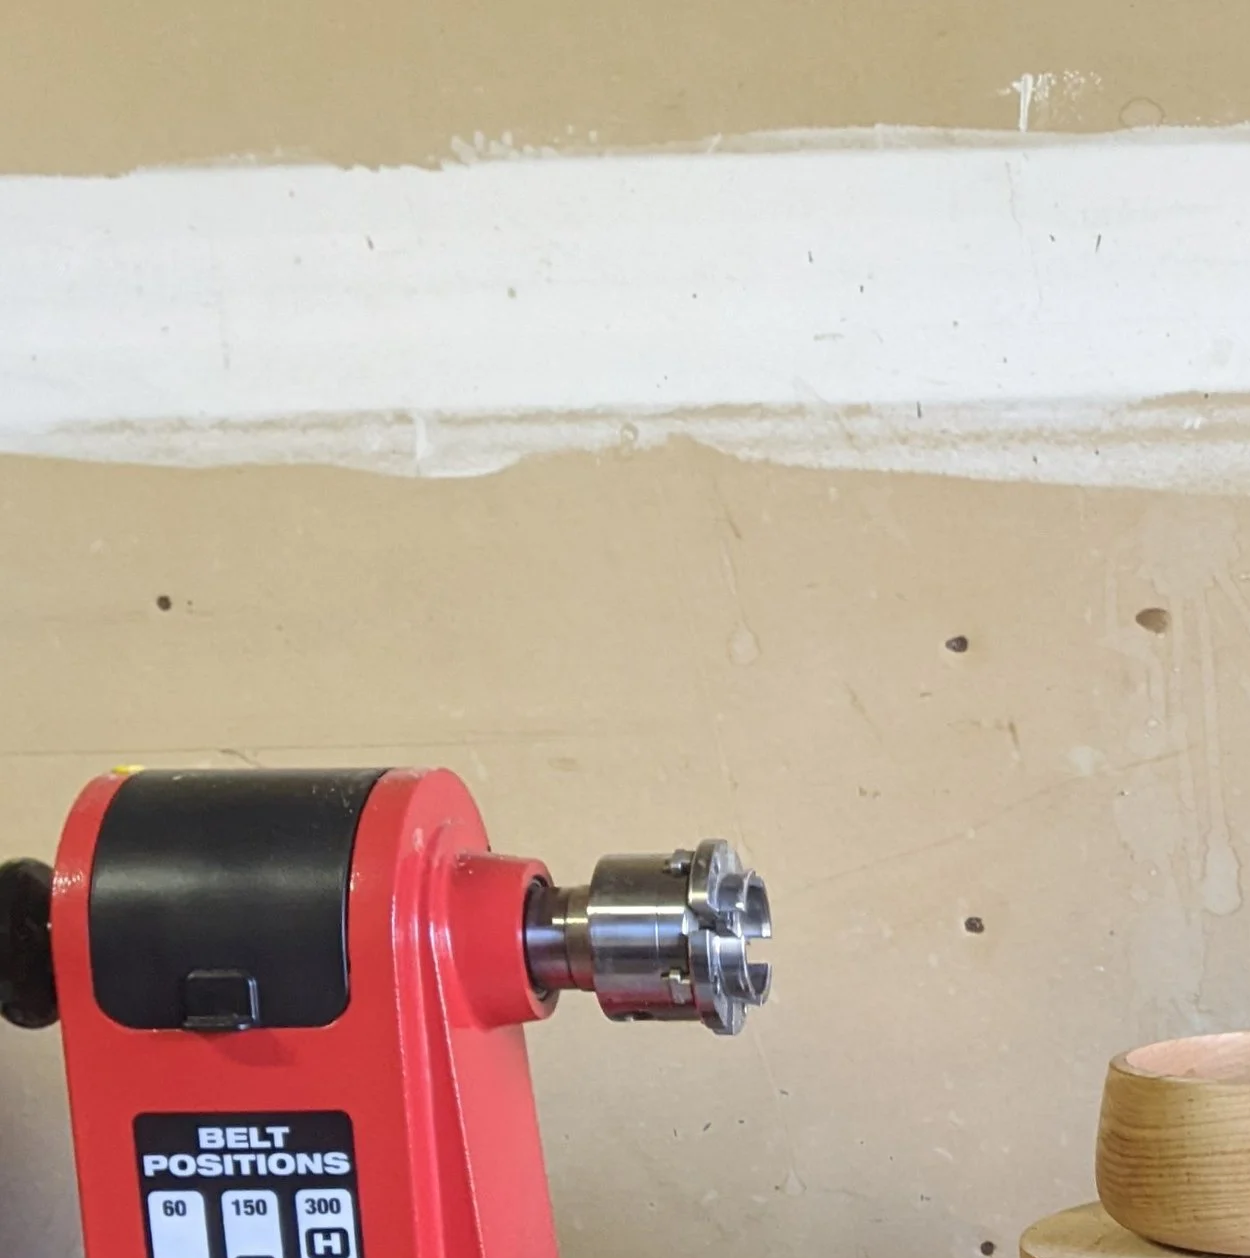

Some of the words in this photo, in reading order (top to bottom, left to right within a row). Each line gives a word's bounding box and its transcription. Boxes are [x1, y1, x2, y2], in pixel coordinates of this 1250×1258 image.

[198, 1127, 289, 1149] BELT
[143, 1152, 351, 1177] POSITIONS
[162, 1200, 187, 1217] 60
[231, 1199, 268, 1217] 150
[305, 1198, 342, 1215] 300
[313, 1232, 342, 1255] H
